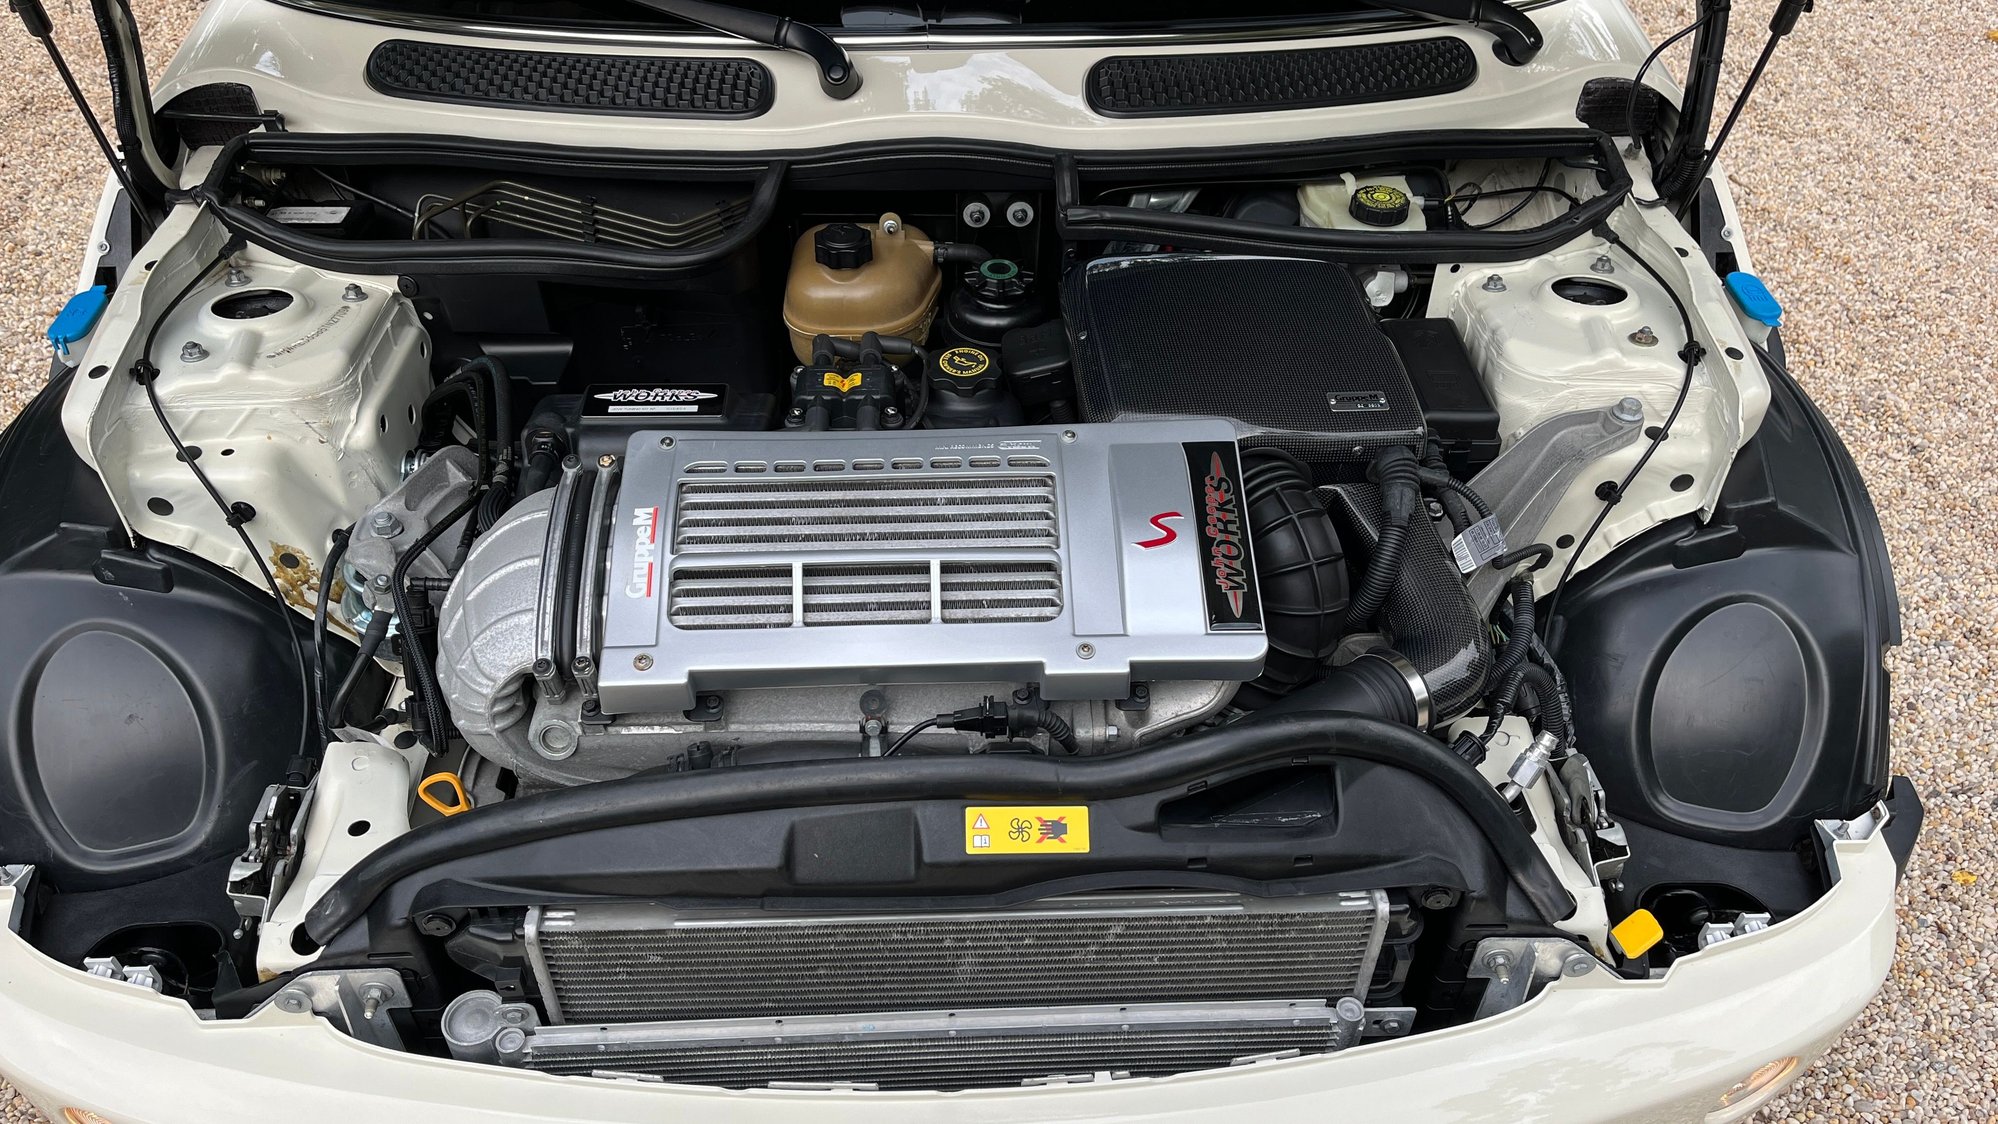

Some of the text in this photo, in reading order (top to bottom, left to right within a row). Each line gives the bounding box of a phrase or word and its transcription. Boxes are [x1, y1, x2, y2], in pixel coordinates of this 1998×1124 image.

[611, 389, 699, 402] WORKS
[625, 507, 655, 599] GruppeM
[1131, 511, 1184, 551] S
[1204, 475, 1230, 592] John Cooper
[1214, 475, 1248, 592] WORKS
